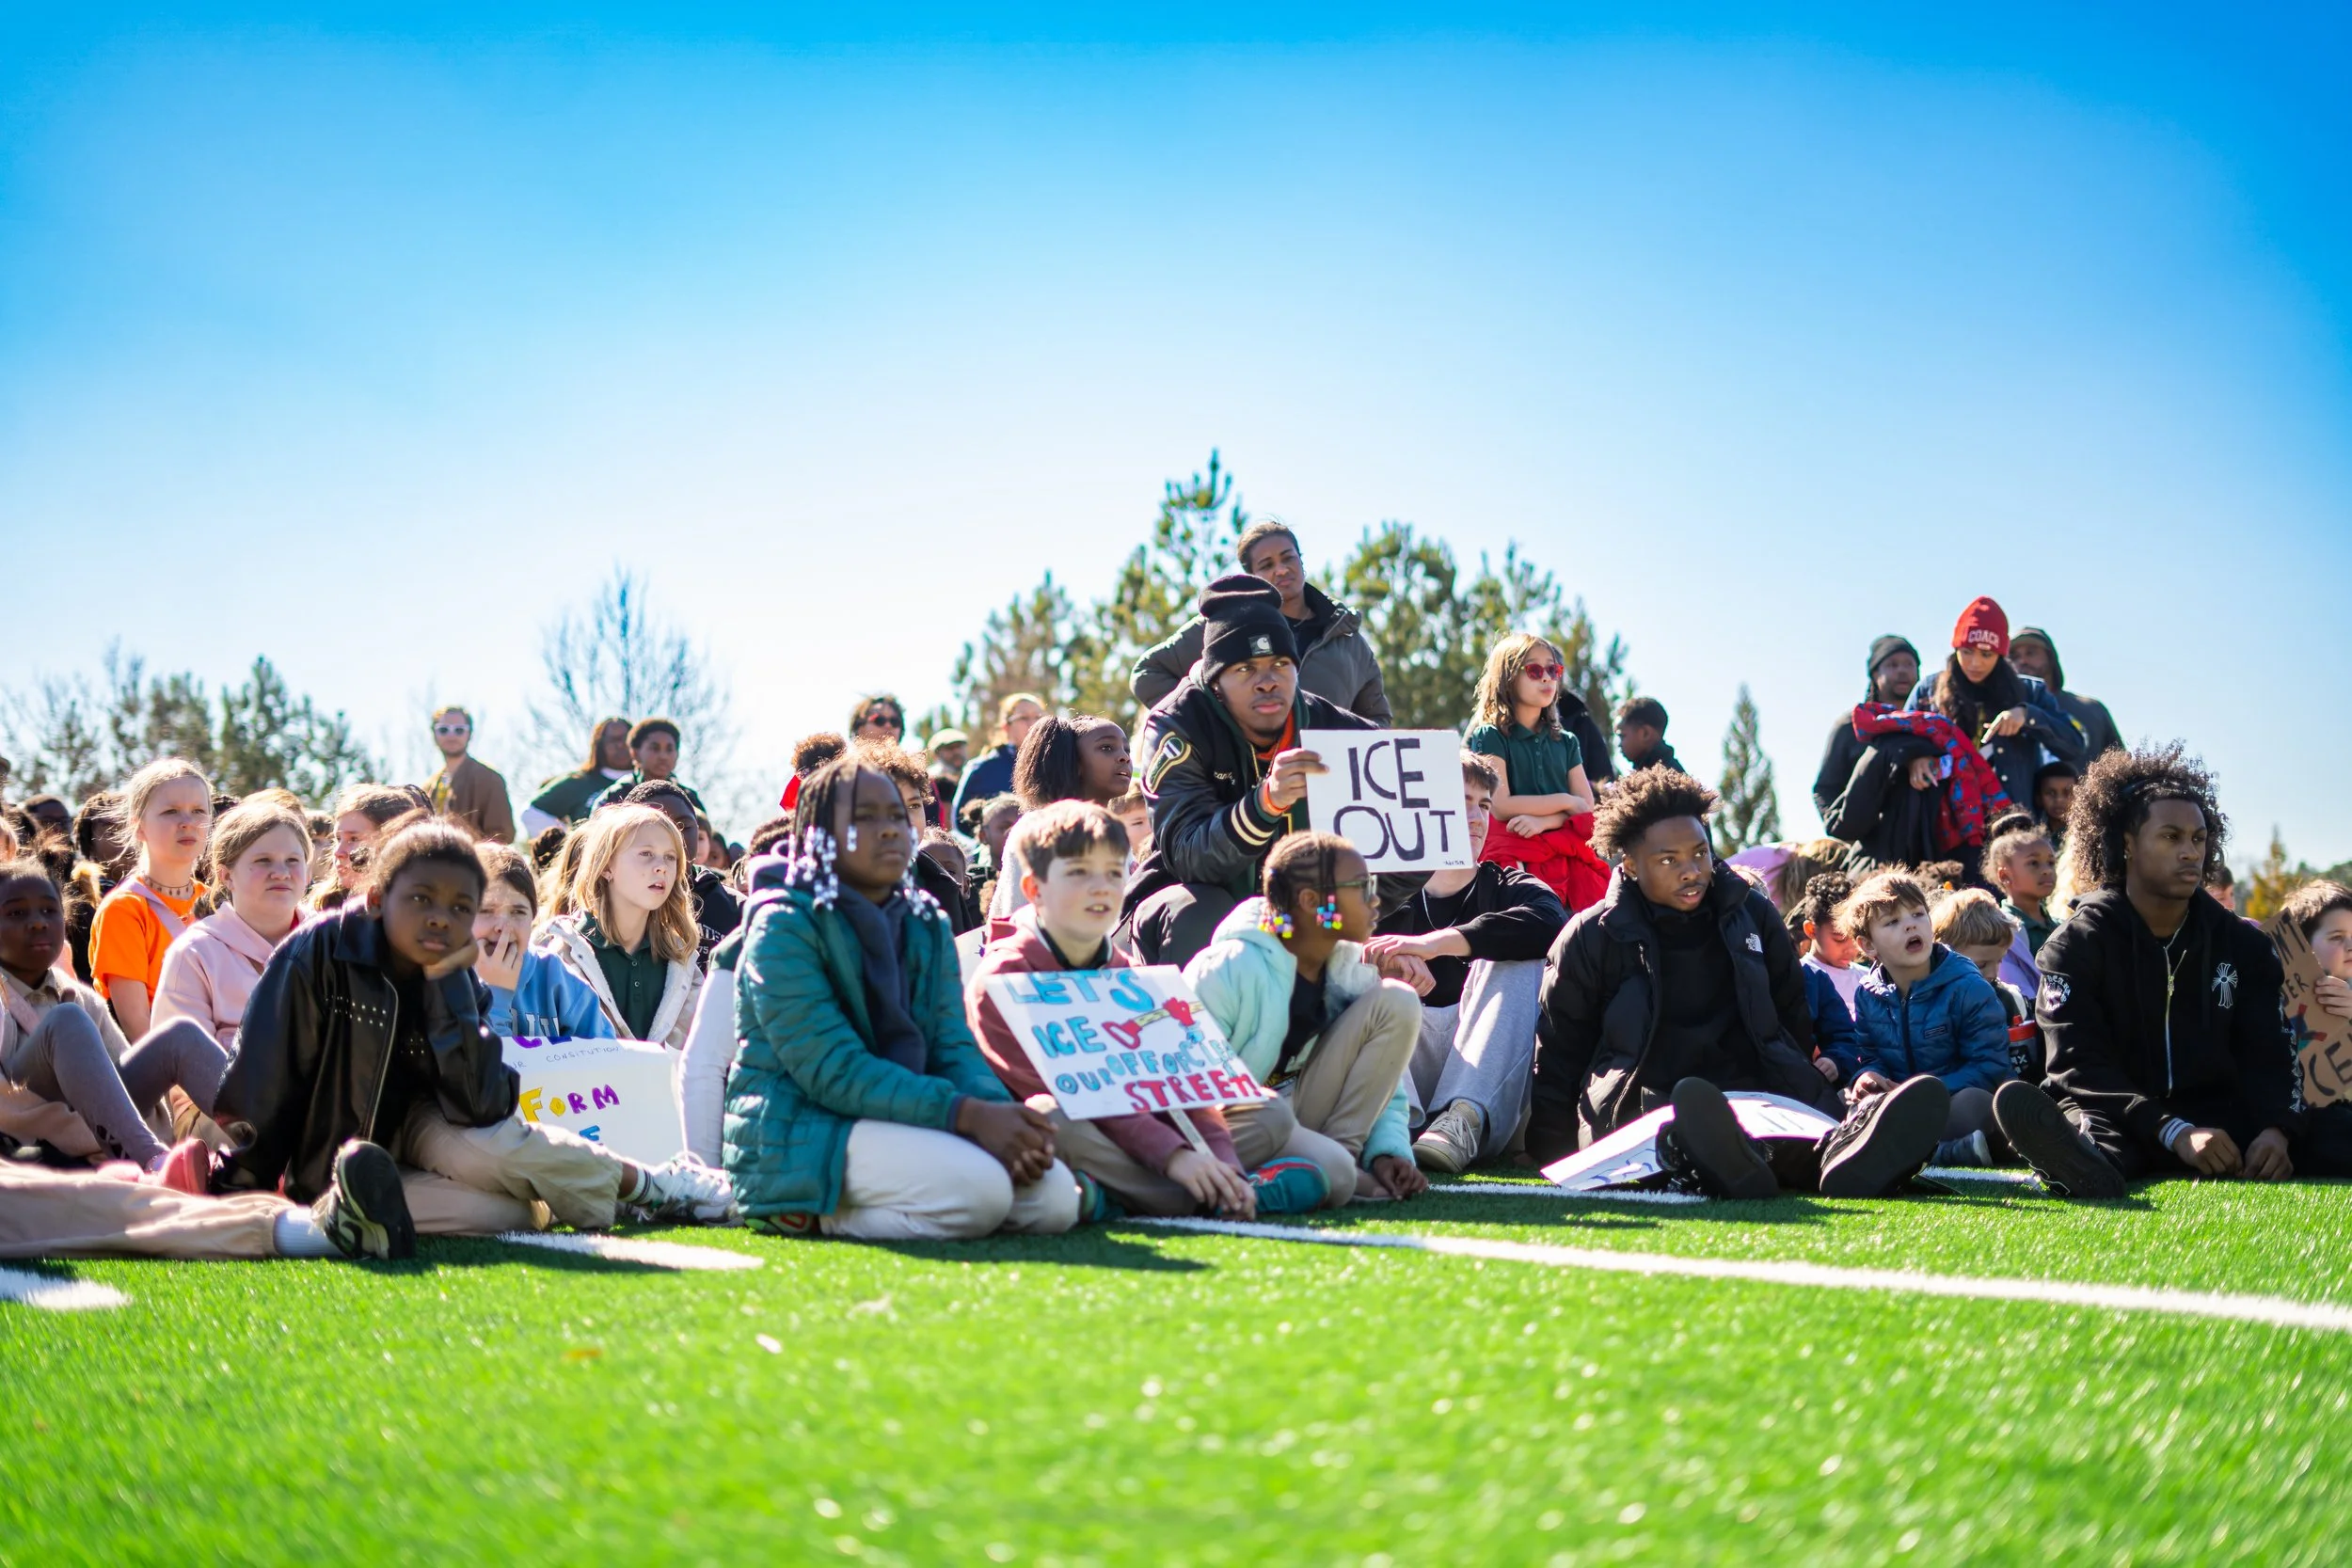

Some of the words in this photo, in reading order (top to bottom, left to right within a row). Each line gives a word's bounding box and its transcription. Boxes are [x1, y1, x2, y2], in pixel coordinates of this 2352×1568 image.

[1968, 629, 1999, 648] COACH
[1348, 738, 1430, 808] ICE
[1333, 805, 1455, 861] OUT
[1002, 969, 1154, 1012] LET'S
[1032, 1016, 1106, 1058] ICE
[1055, 1069, 1115, 1094] OUR
[1104, 1051, 1160, 1076] OFF
[519, 1085, 620, 1122] FORM
